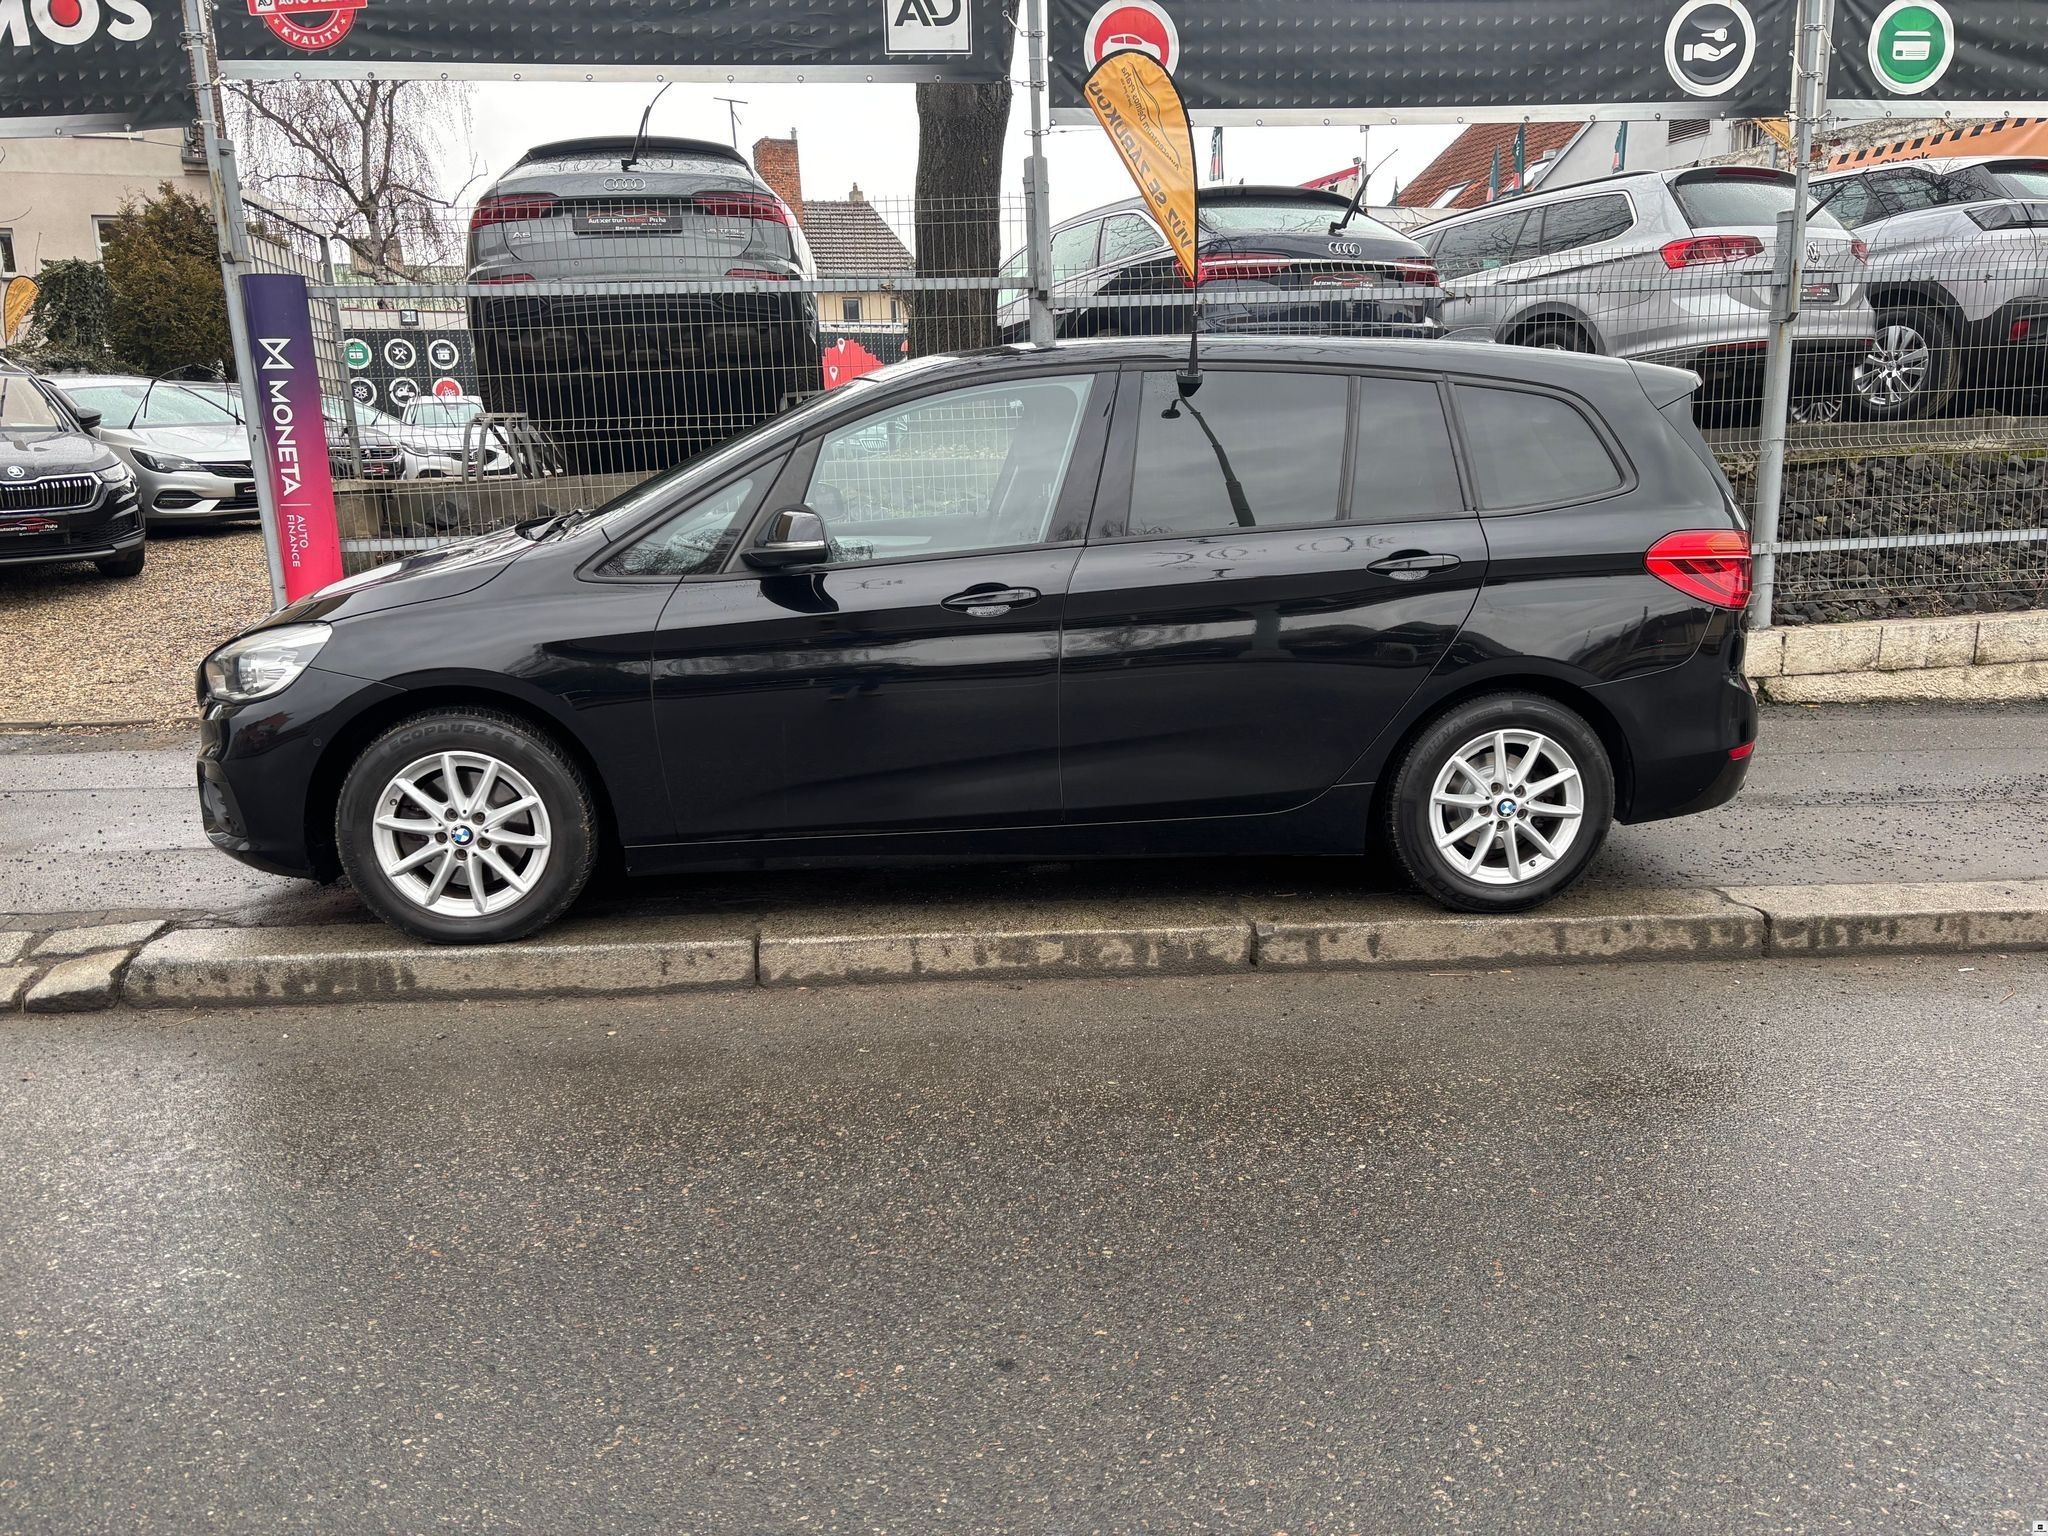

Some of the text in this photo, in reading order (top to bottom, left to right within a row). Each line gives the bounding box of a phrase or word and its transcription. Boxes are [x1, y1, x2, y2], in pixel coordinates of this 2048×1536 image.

[281, 25, 341, 45] KVALITY
[268, 380, 302, 497] MONETA
[286, 514, 301, 568] FINANCE
[296, 514, 309, 549] AUTO
